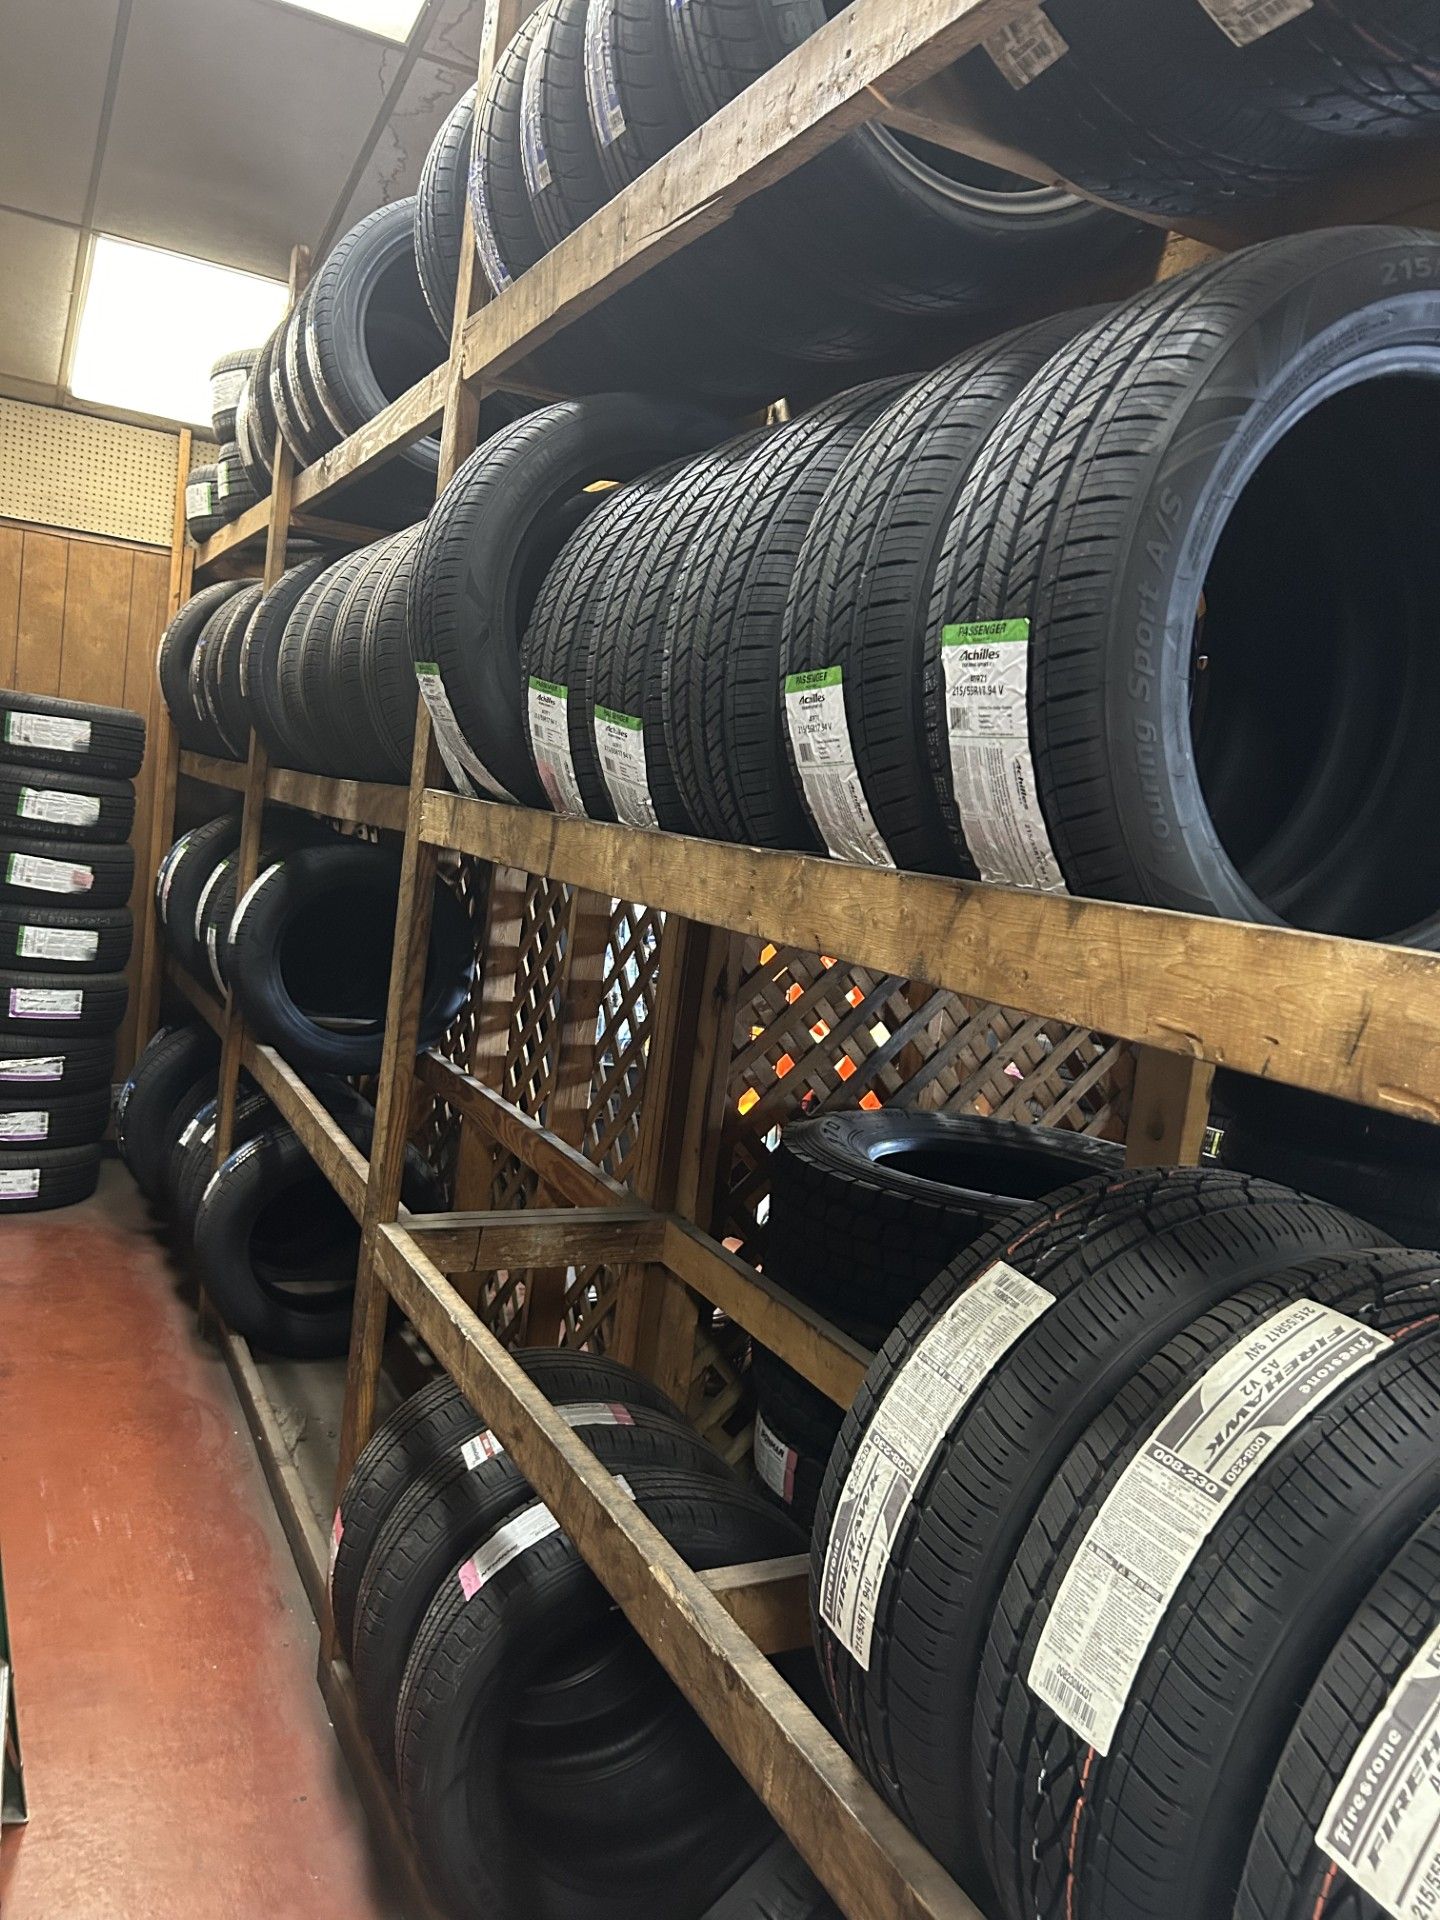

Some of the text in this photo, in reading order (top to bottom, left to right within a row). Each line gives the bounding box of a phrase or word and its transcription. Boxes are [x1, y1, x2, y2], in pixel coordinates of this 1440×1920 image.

[1128, 580, 1160, 703] Sport
[1145, 487, 1185, 572] A/S
[958, 622, 1007, 637] PASSENGER
[959, 648, 1000, 661] Achilles
[1015, 758, 1029, 811] Achilles
[1244, 1306, 1316, 1361] 215/55R17 94V
[1239, 1358, 1280, 1396] AS V2
[1298, 1336, 1374, 1394] Firestone
[1204, 1325, 1346, 1464] FIREHAWK
[873, 1434, 913, 1475] 008-230
[1153, 1448, 1218, 1494] 008-230
[1226, 1436, 1267, 1481] 008-230
[836, 1468, 880, 1629] FIREHAWK
[851, 1532, 867, 1578] AS V2
[824, 1538, 841, 1614] Firestone
[1334, 1729, 1402, 1847] Firestone
